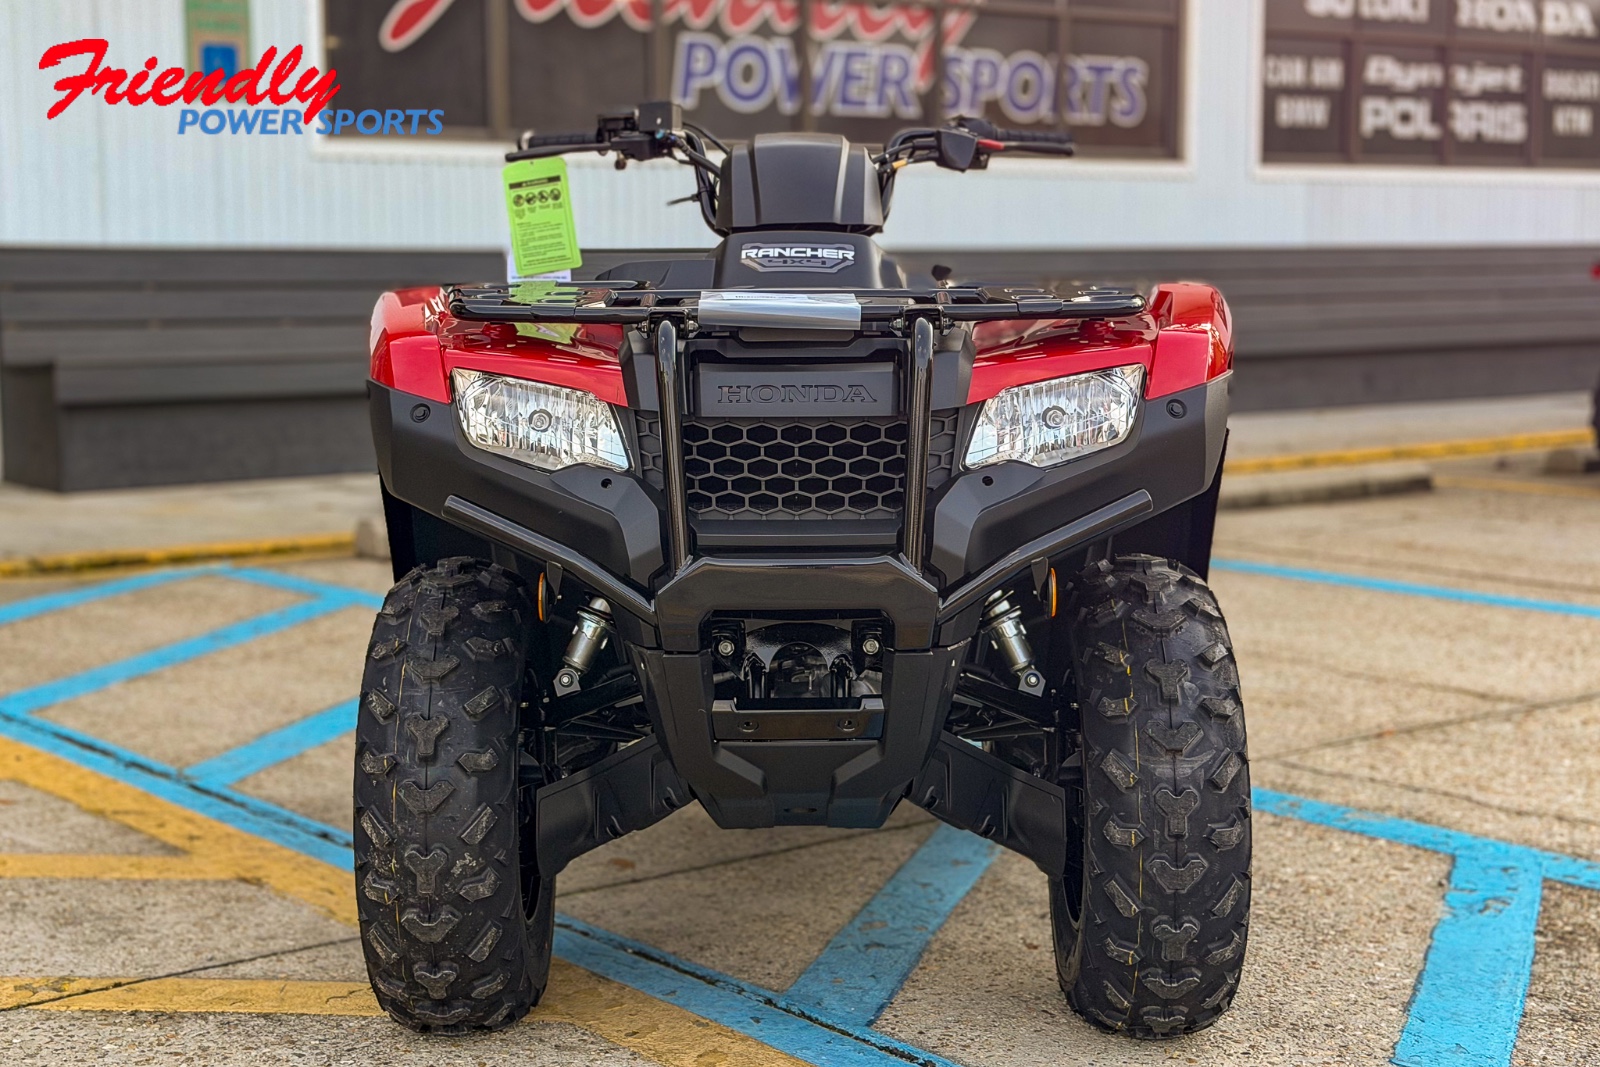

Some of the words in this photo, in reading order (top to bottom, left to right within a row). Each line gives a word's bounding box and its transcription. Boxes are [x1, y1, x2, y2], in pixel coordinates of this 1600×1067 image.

[676, 33, 918, 117] POWER
[942, 48, 1146, 126] SPORTS
[741, 247, 855, 260] RANCHER
[717, 384, 877, 404] HONDA
